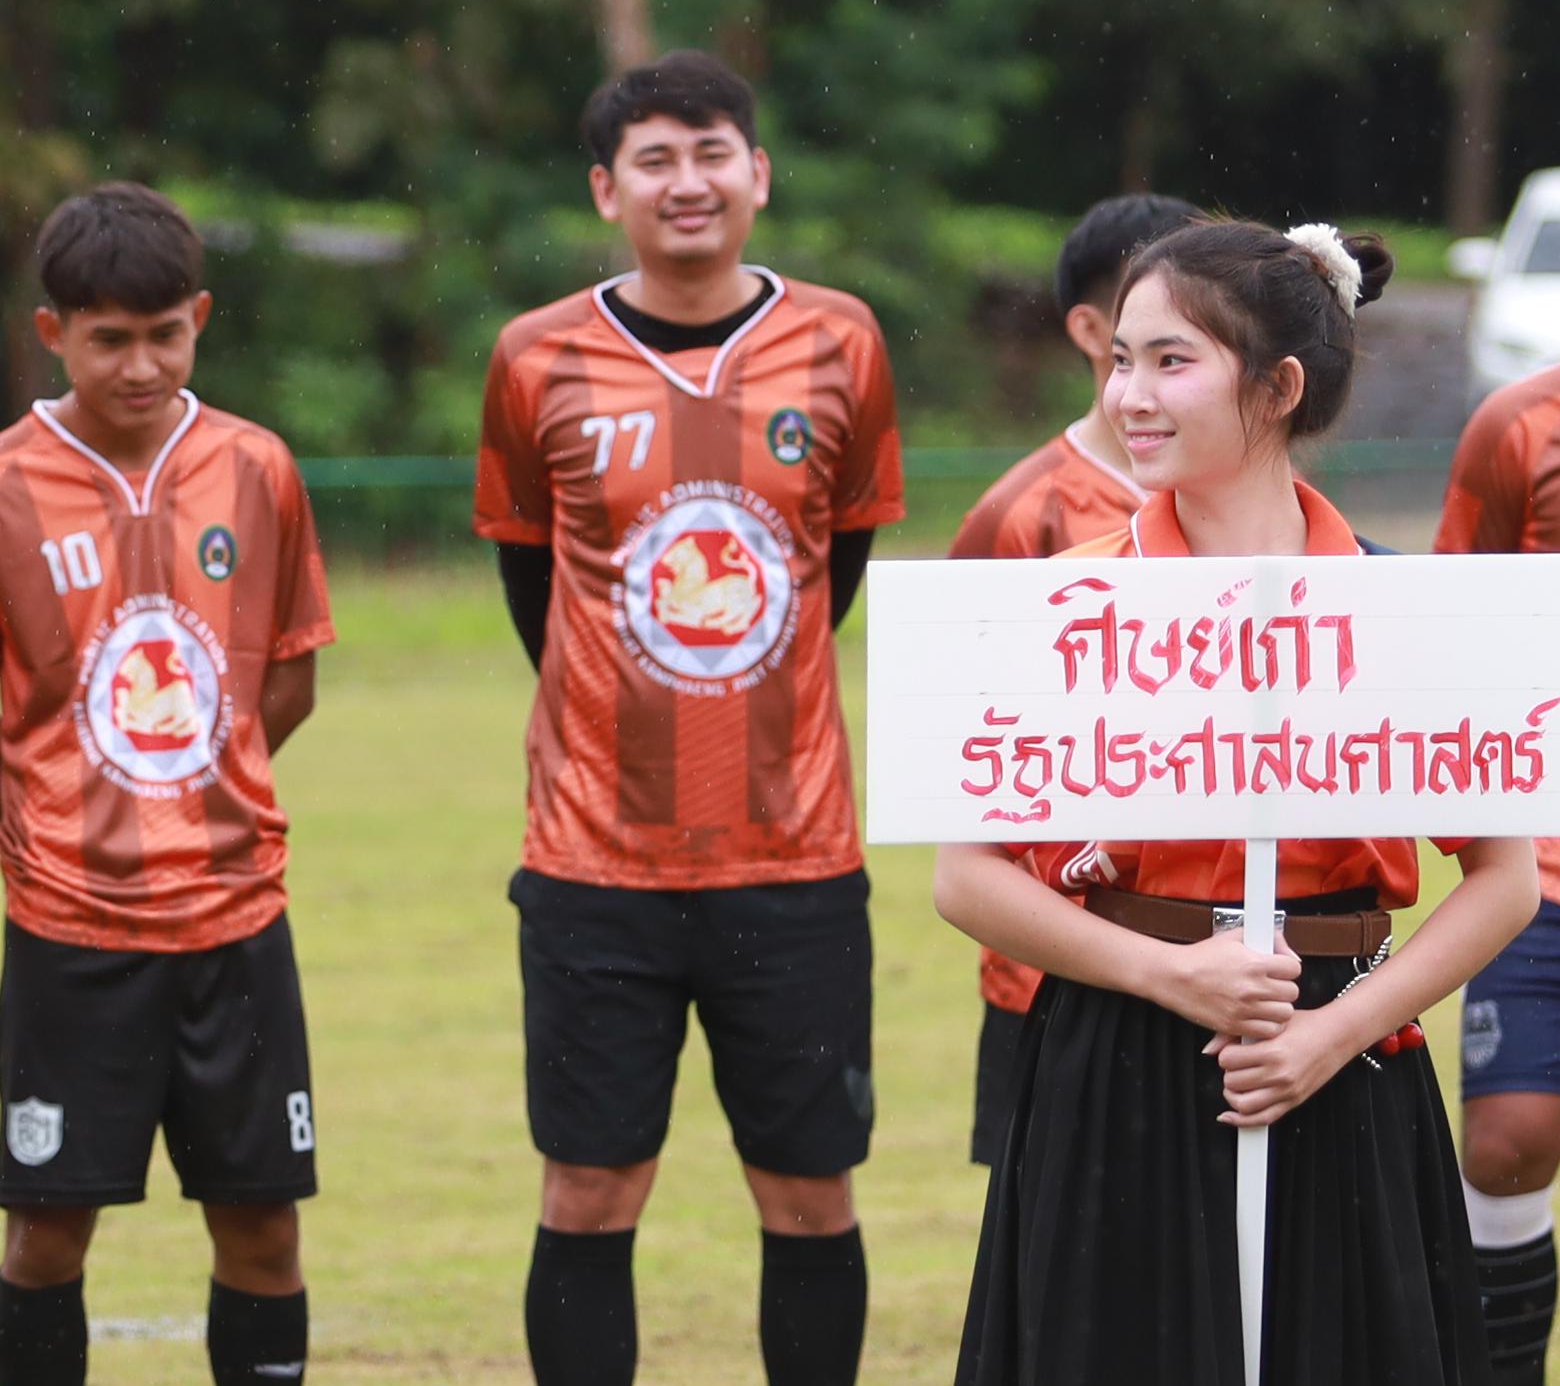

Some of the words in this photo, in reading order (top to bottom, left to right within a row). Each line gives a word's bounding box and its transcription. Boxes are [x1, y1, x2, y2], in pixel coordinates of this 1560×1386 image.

[581, 410, 656, 475] 77
[39, 529, 104, 596] 10
[1047, 576, 1357, 696] ศิษย์เก่า
[286, 1090, 314, 1152] 8
